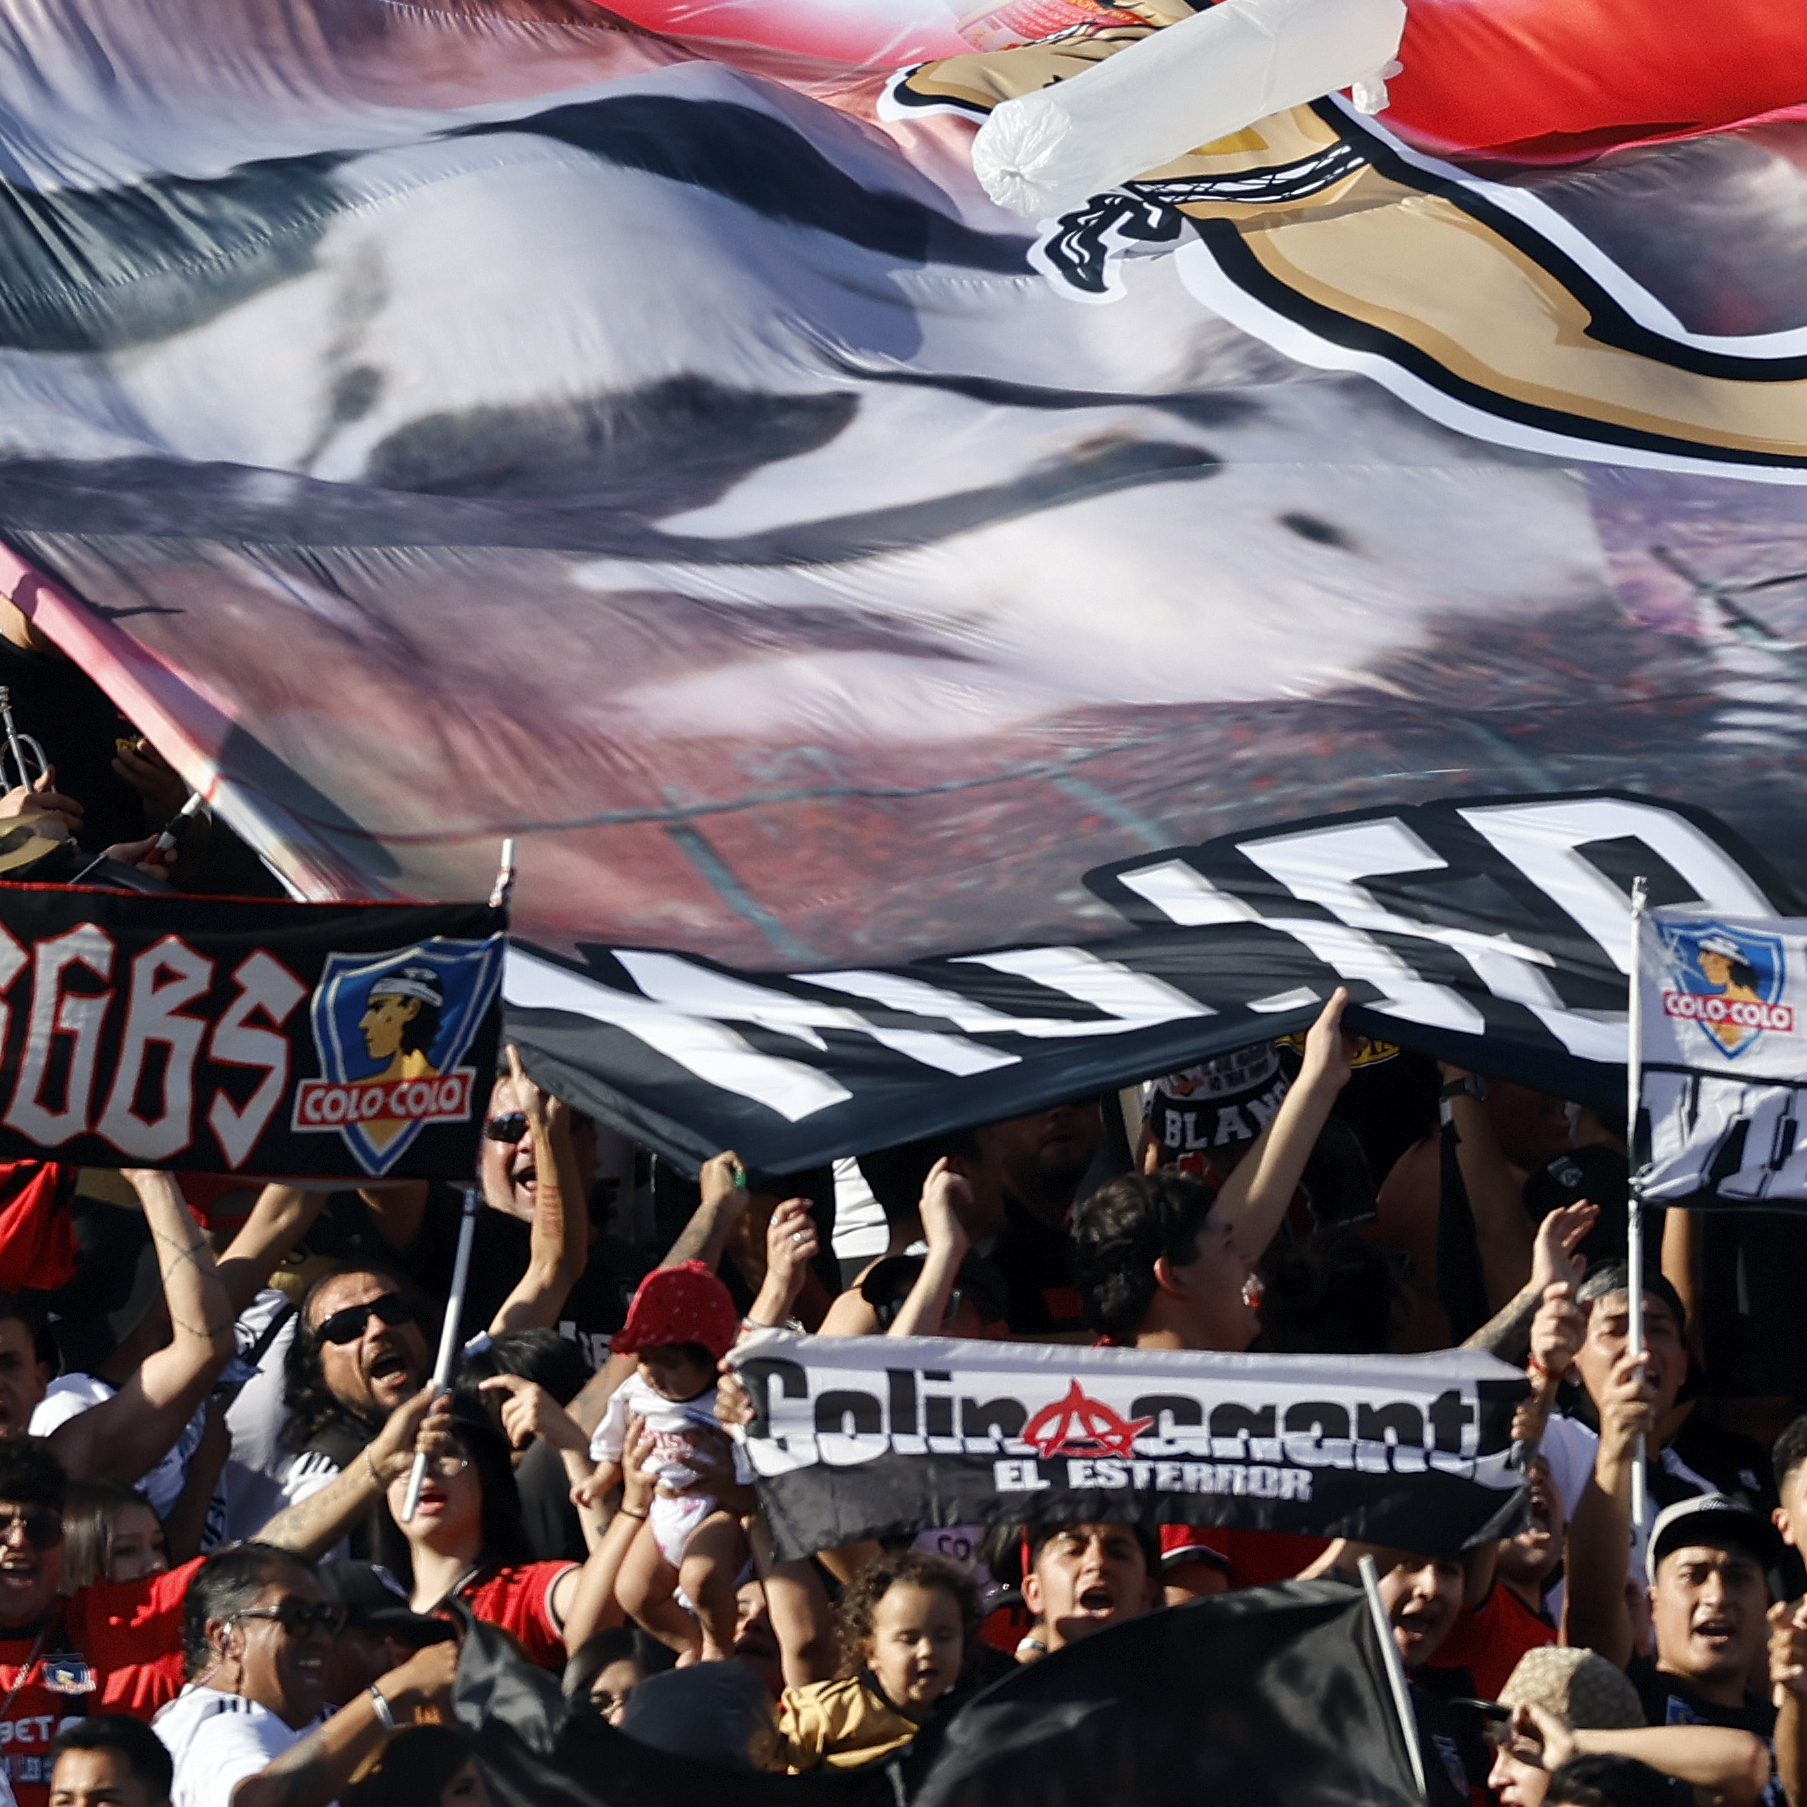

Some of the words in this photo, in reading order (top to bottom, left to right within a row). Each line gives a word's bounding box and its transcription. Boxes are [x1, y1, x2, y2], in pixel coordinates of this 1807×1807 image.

[1663, 994, 1793, 1031] COLO-COLO
[302, 1073, 464, 1122] COLO-COLO
[993, 1460, 1051, 1494] EL
[1069, 1460, 1315, 1503] ESTERROR
